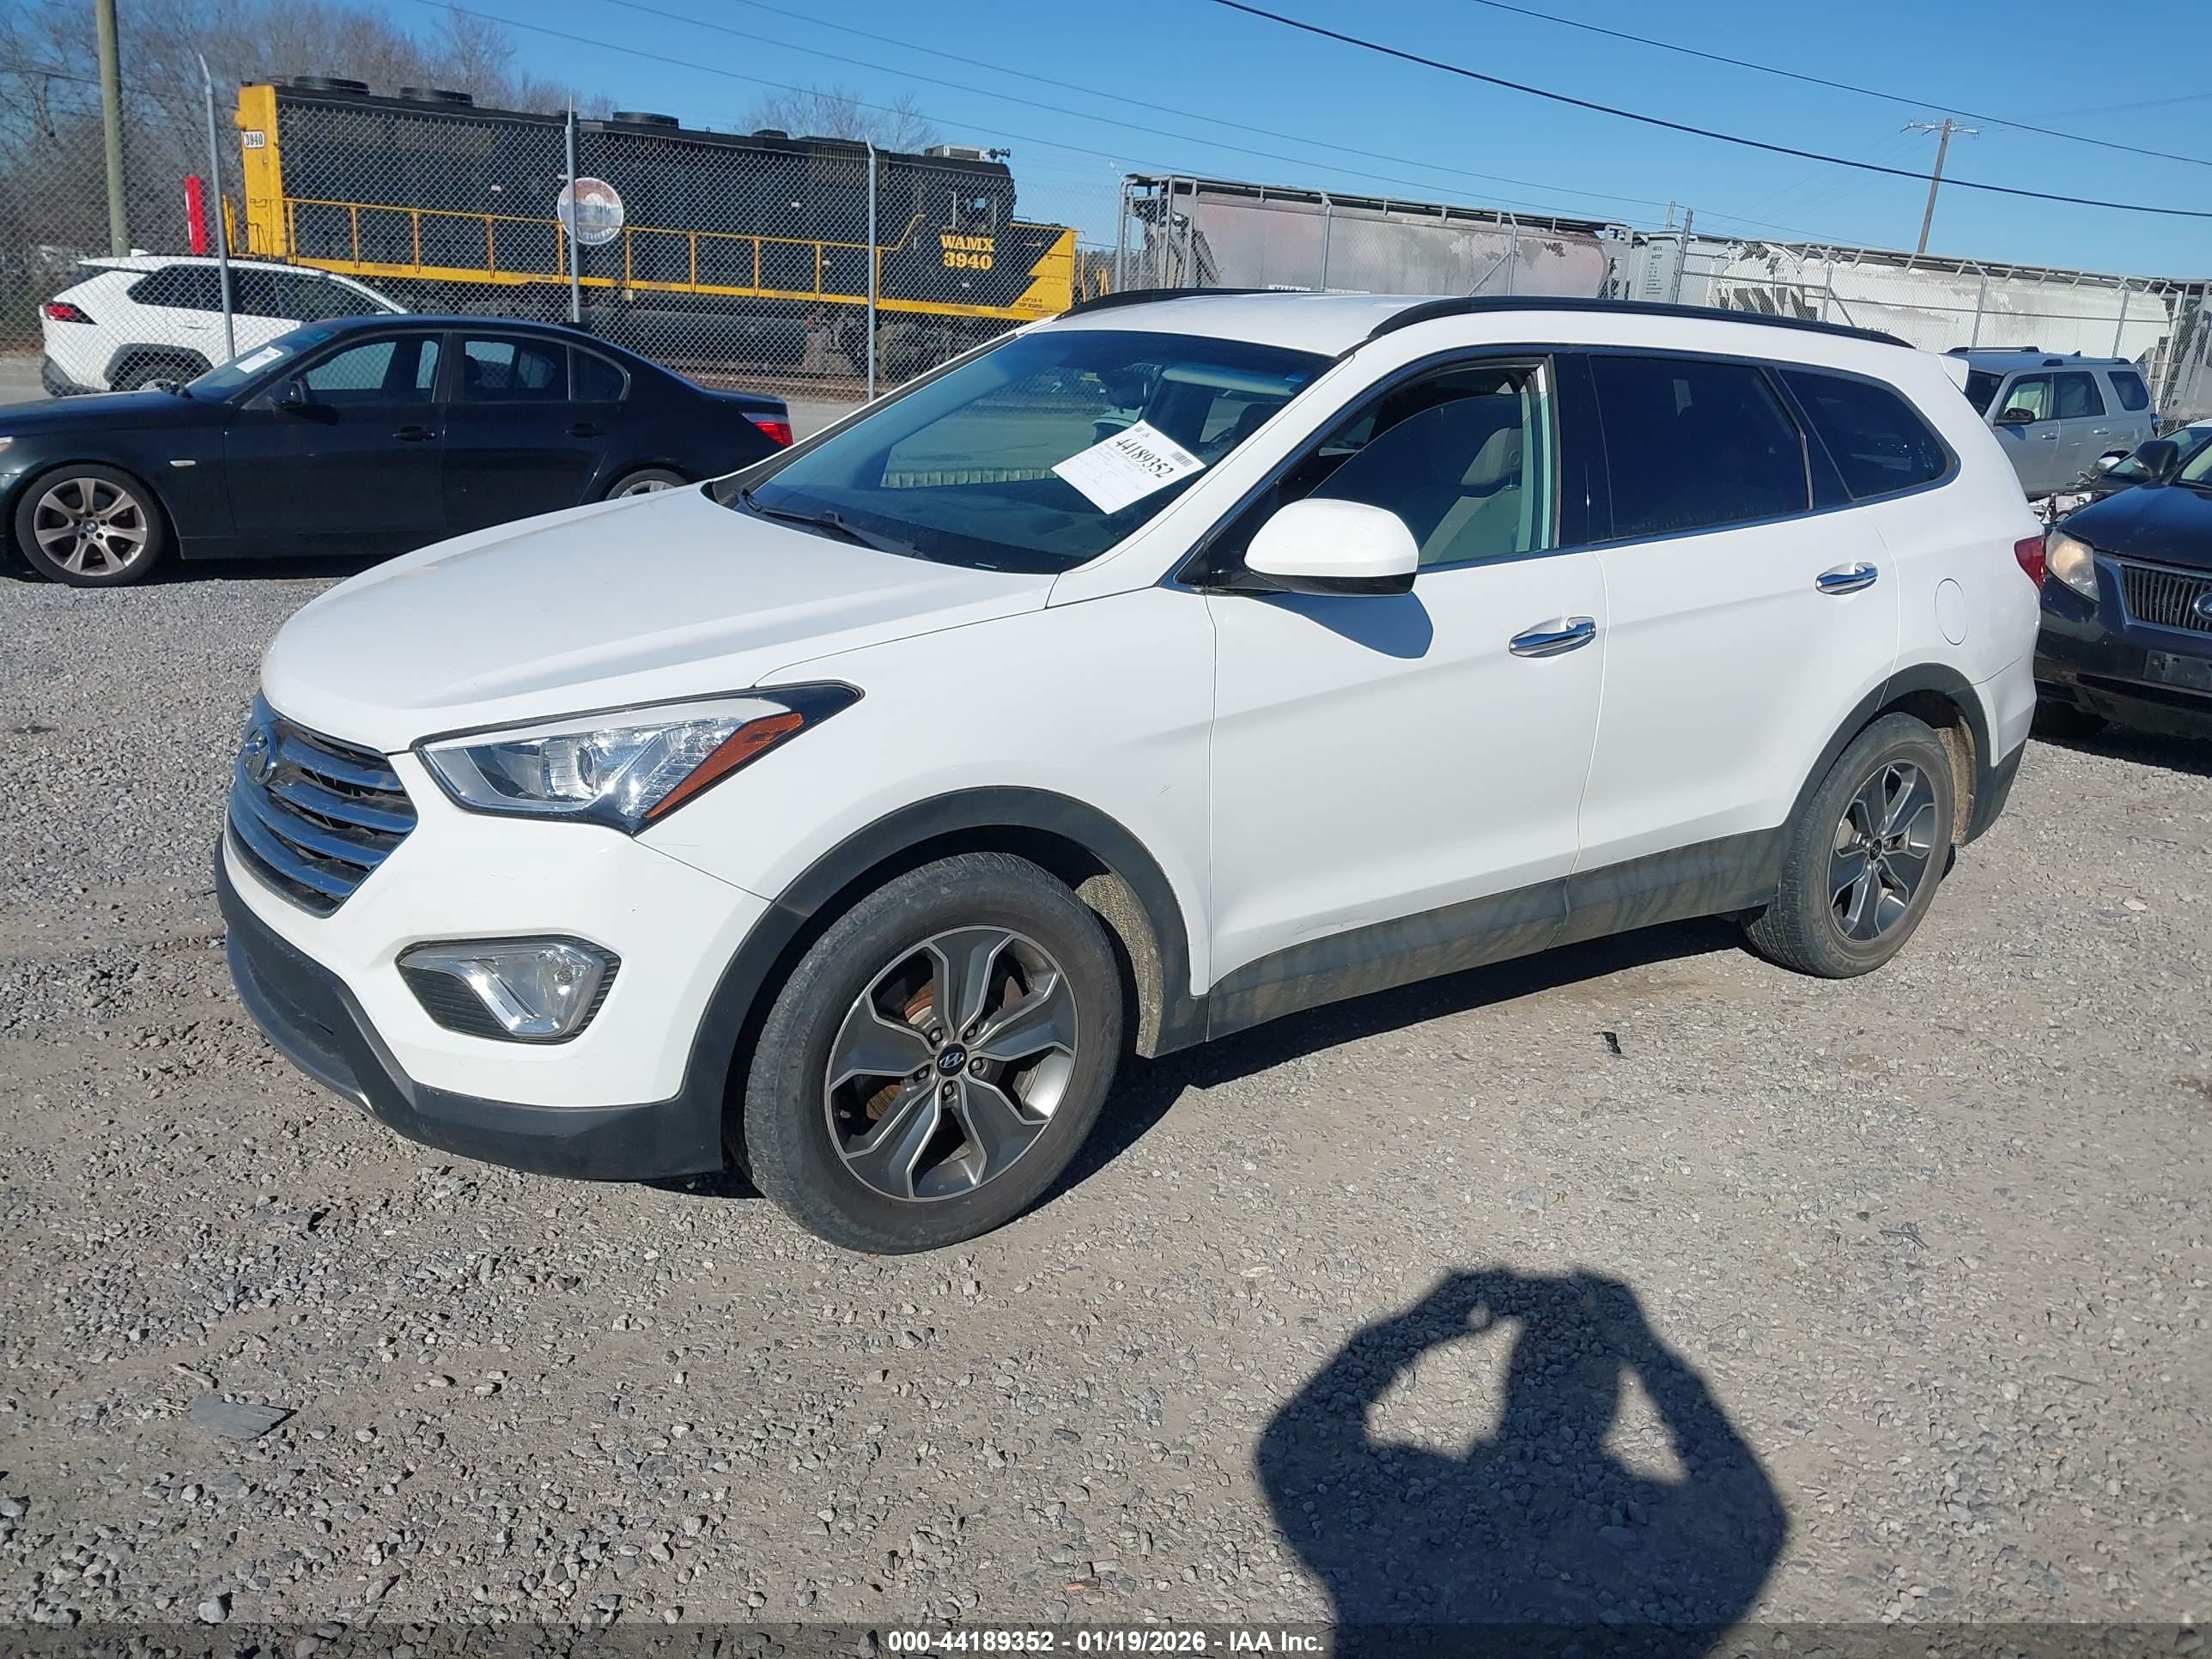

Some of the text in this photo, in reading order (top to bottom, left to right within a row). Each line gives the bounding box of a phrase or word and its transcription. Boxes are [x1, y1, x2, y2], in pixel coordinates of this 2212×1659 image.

[245, 133, 264, 146] 3940
[939, 234, 995, 252] WAMX
[943, 252, 994, 270] 3940
[1115, 438, 1175, 479] 44189352
